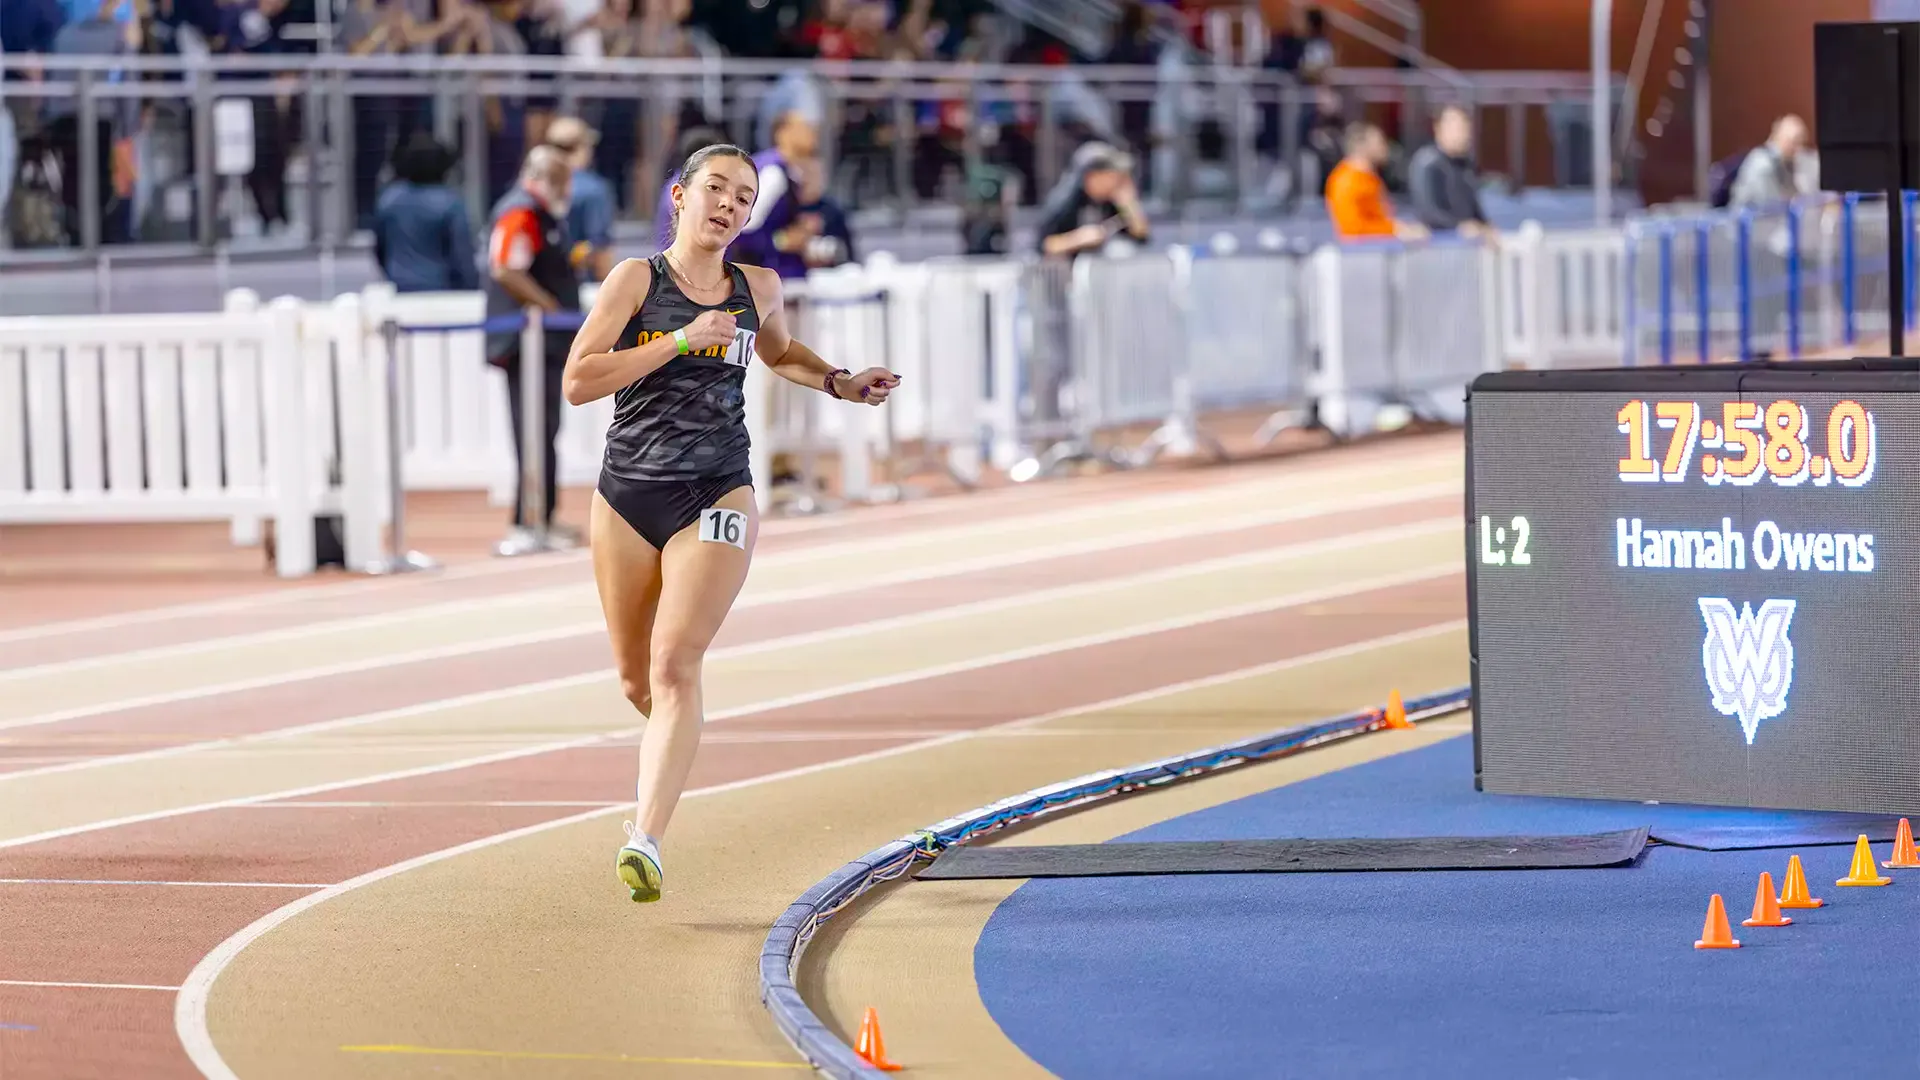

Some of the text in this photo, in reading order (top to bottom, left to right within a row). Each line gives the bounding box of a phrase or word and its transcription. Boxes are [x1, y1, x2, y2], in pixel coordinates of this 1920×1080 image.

[734, 331, 755, 366] 16
[1617, 399, 1876, 487] 17:58.0
[709, 510, 741, 544] 16
[1511, 516, 1531, 565] 2
[1616, 517, 1875, 572] Hannah Owens
